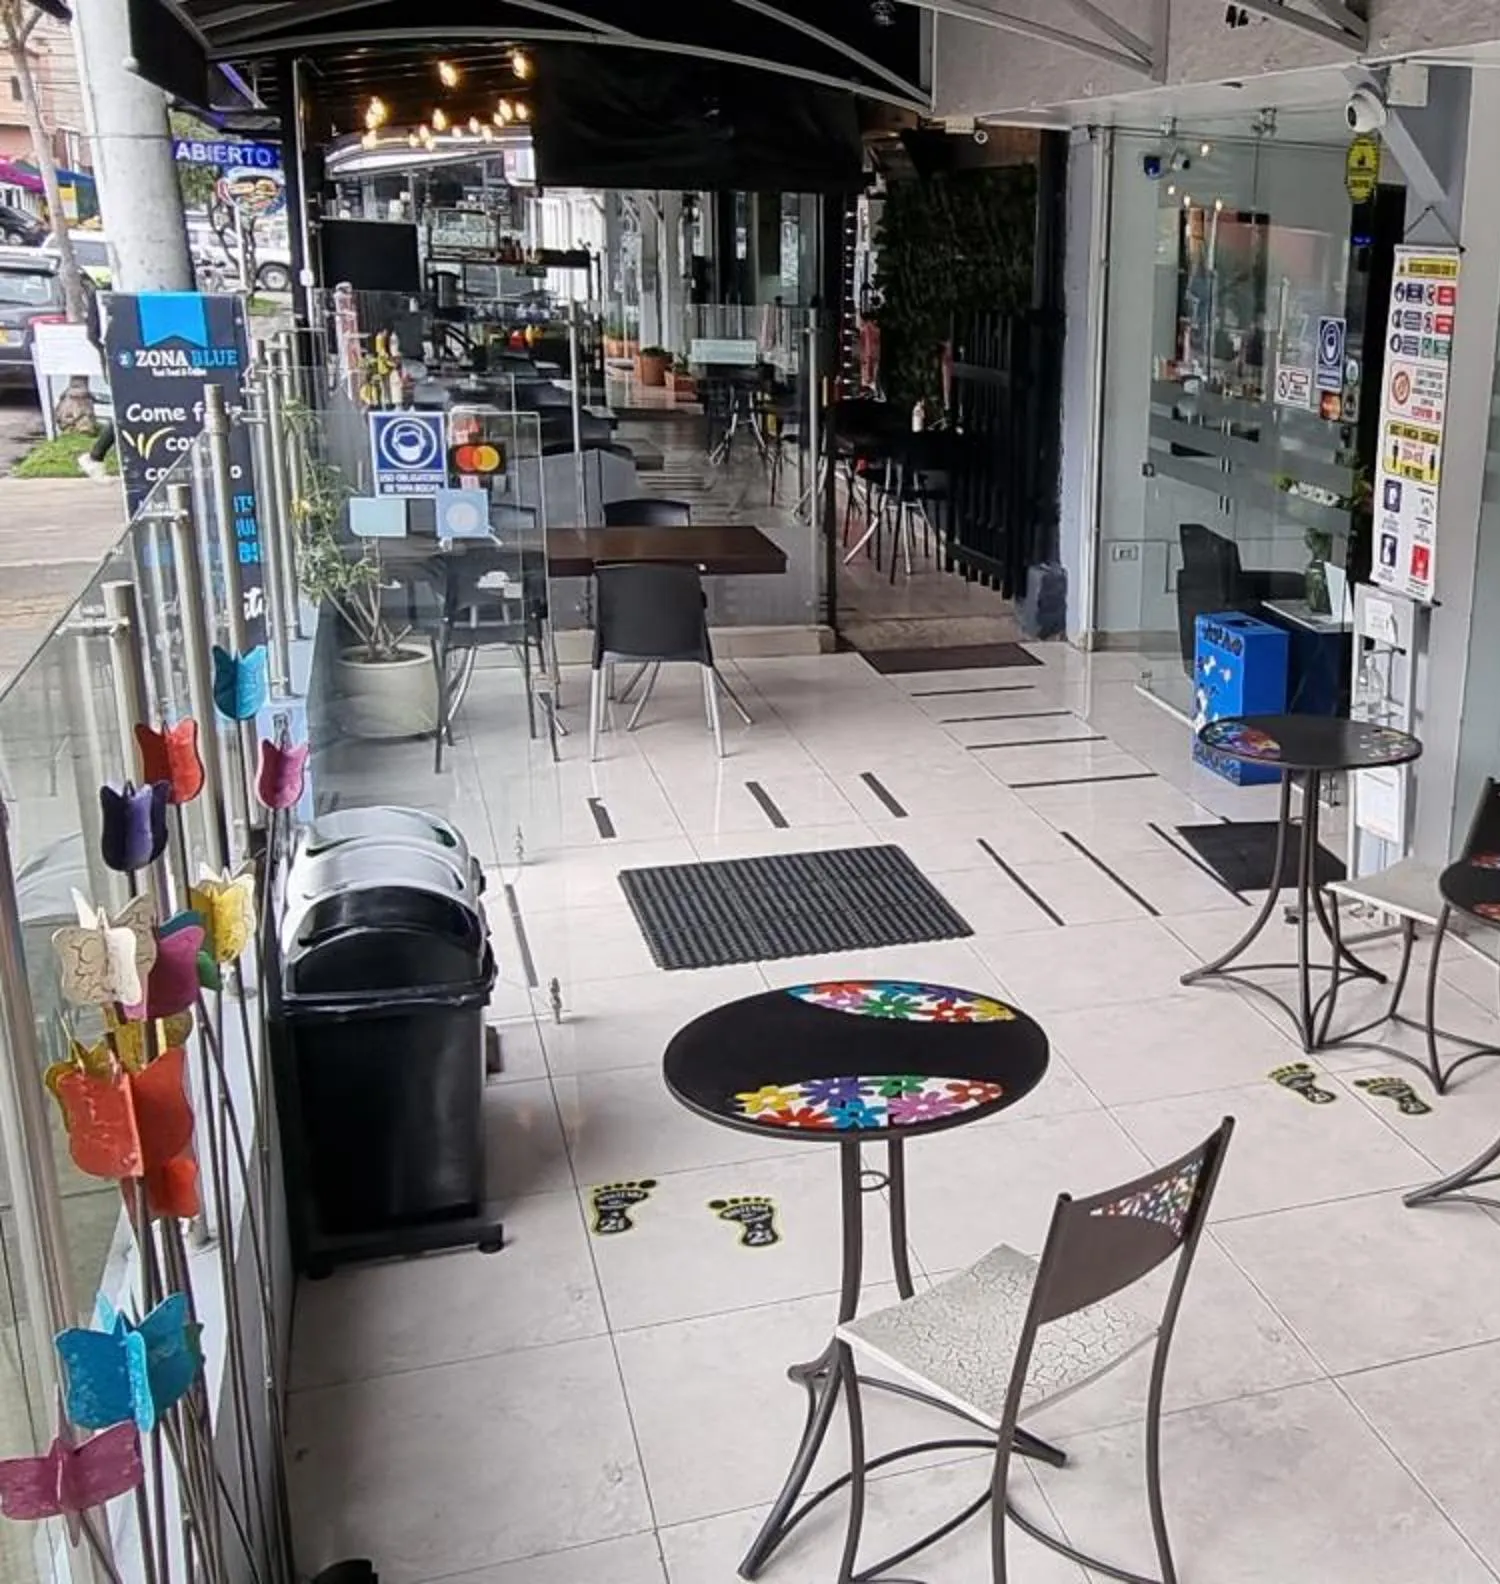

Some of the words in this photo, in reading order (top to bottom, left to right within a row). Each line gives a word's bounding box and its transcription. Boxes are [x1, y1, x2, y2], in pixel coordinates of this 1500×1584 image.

[175, 141, 272, 166] ABIERTO
[135, 350, 188, 367] ZONA
[191, 350, 238, 367] BLUE
[126, 403, 187, 423] Come
